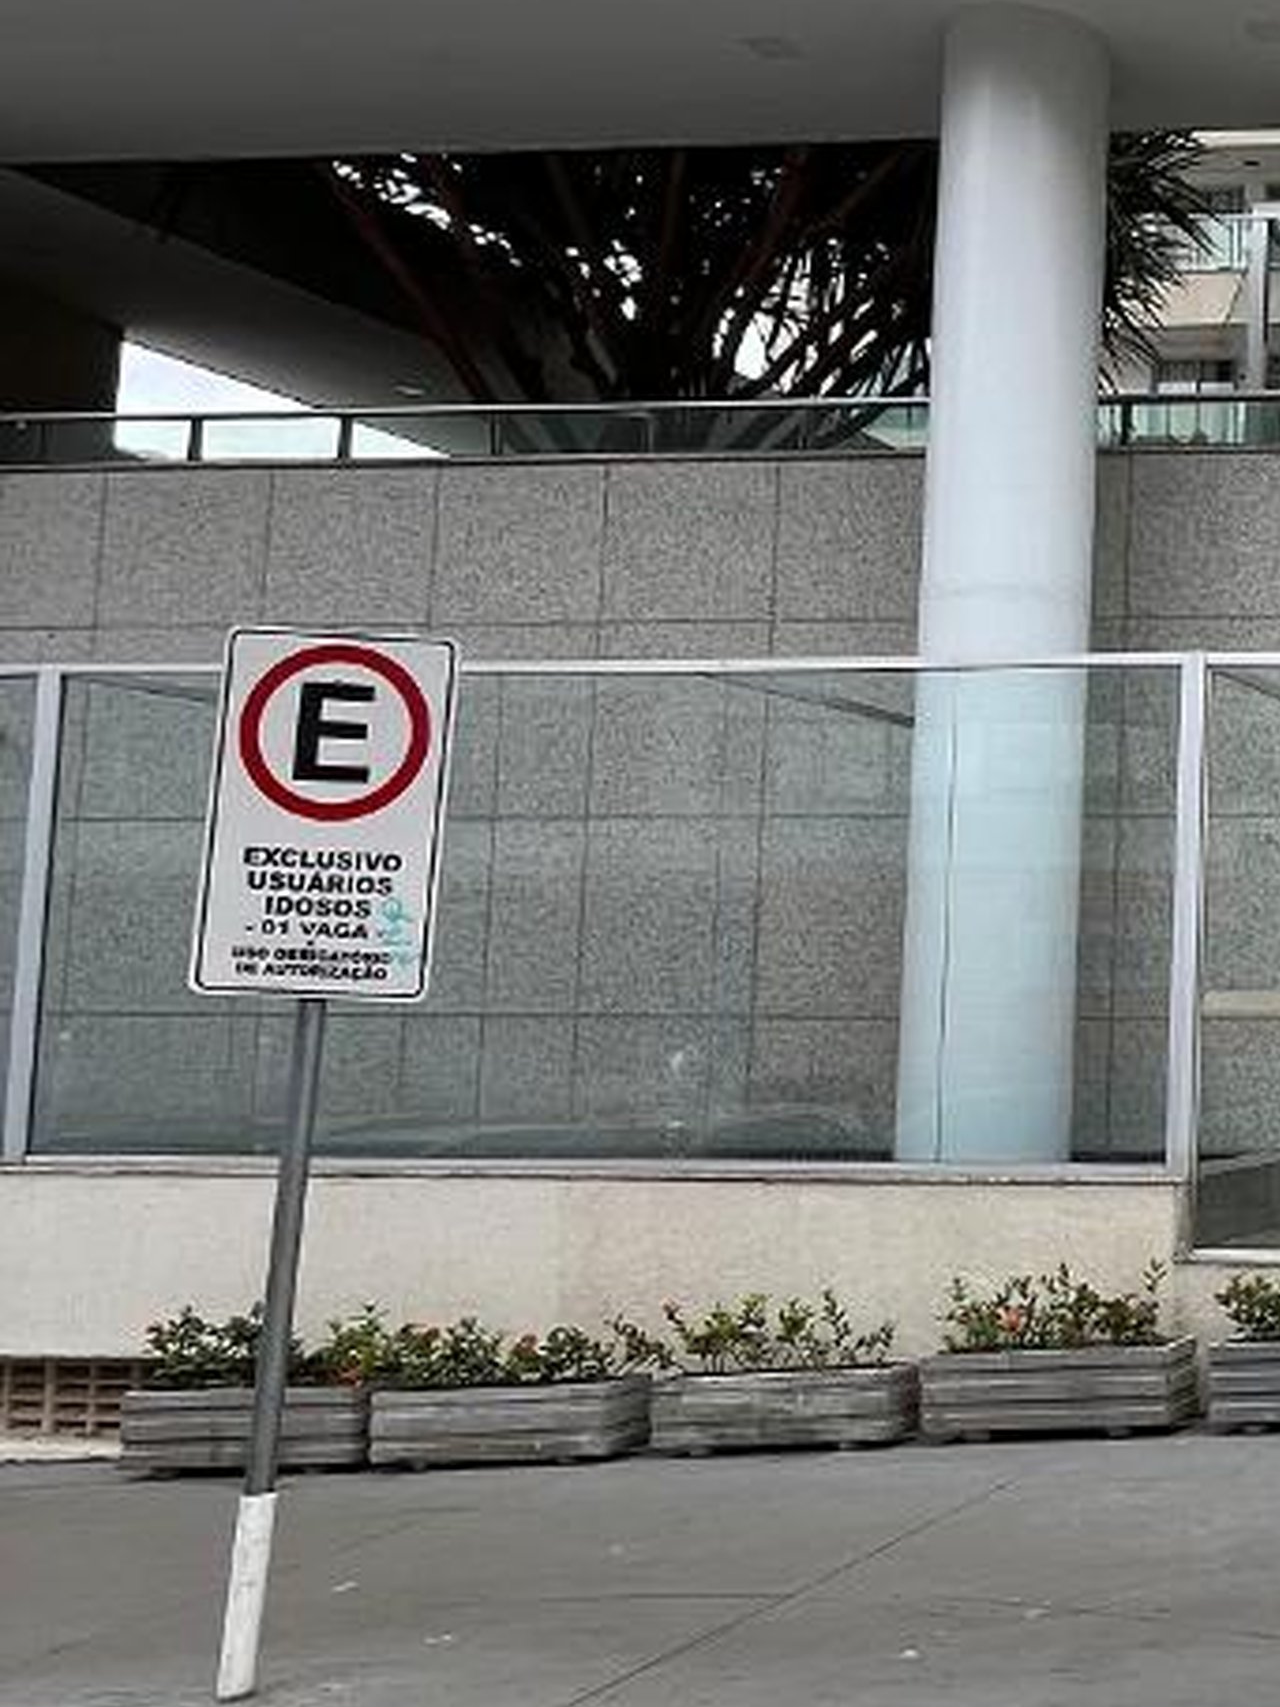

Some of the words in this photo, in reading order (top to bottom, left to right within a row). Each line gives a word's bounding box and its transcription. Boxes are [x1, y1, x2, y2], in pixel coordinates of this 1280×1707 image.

[292, 681, 376, 783] E
[243, 847, 402, 872] EXCLUSIVO
[247, 871, 392, 896] USUÁRIOS
[264, 896, 371, 919] IDOSOS
[300, 922, 368, 939] VAGA
